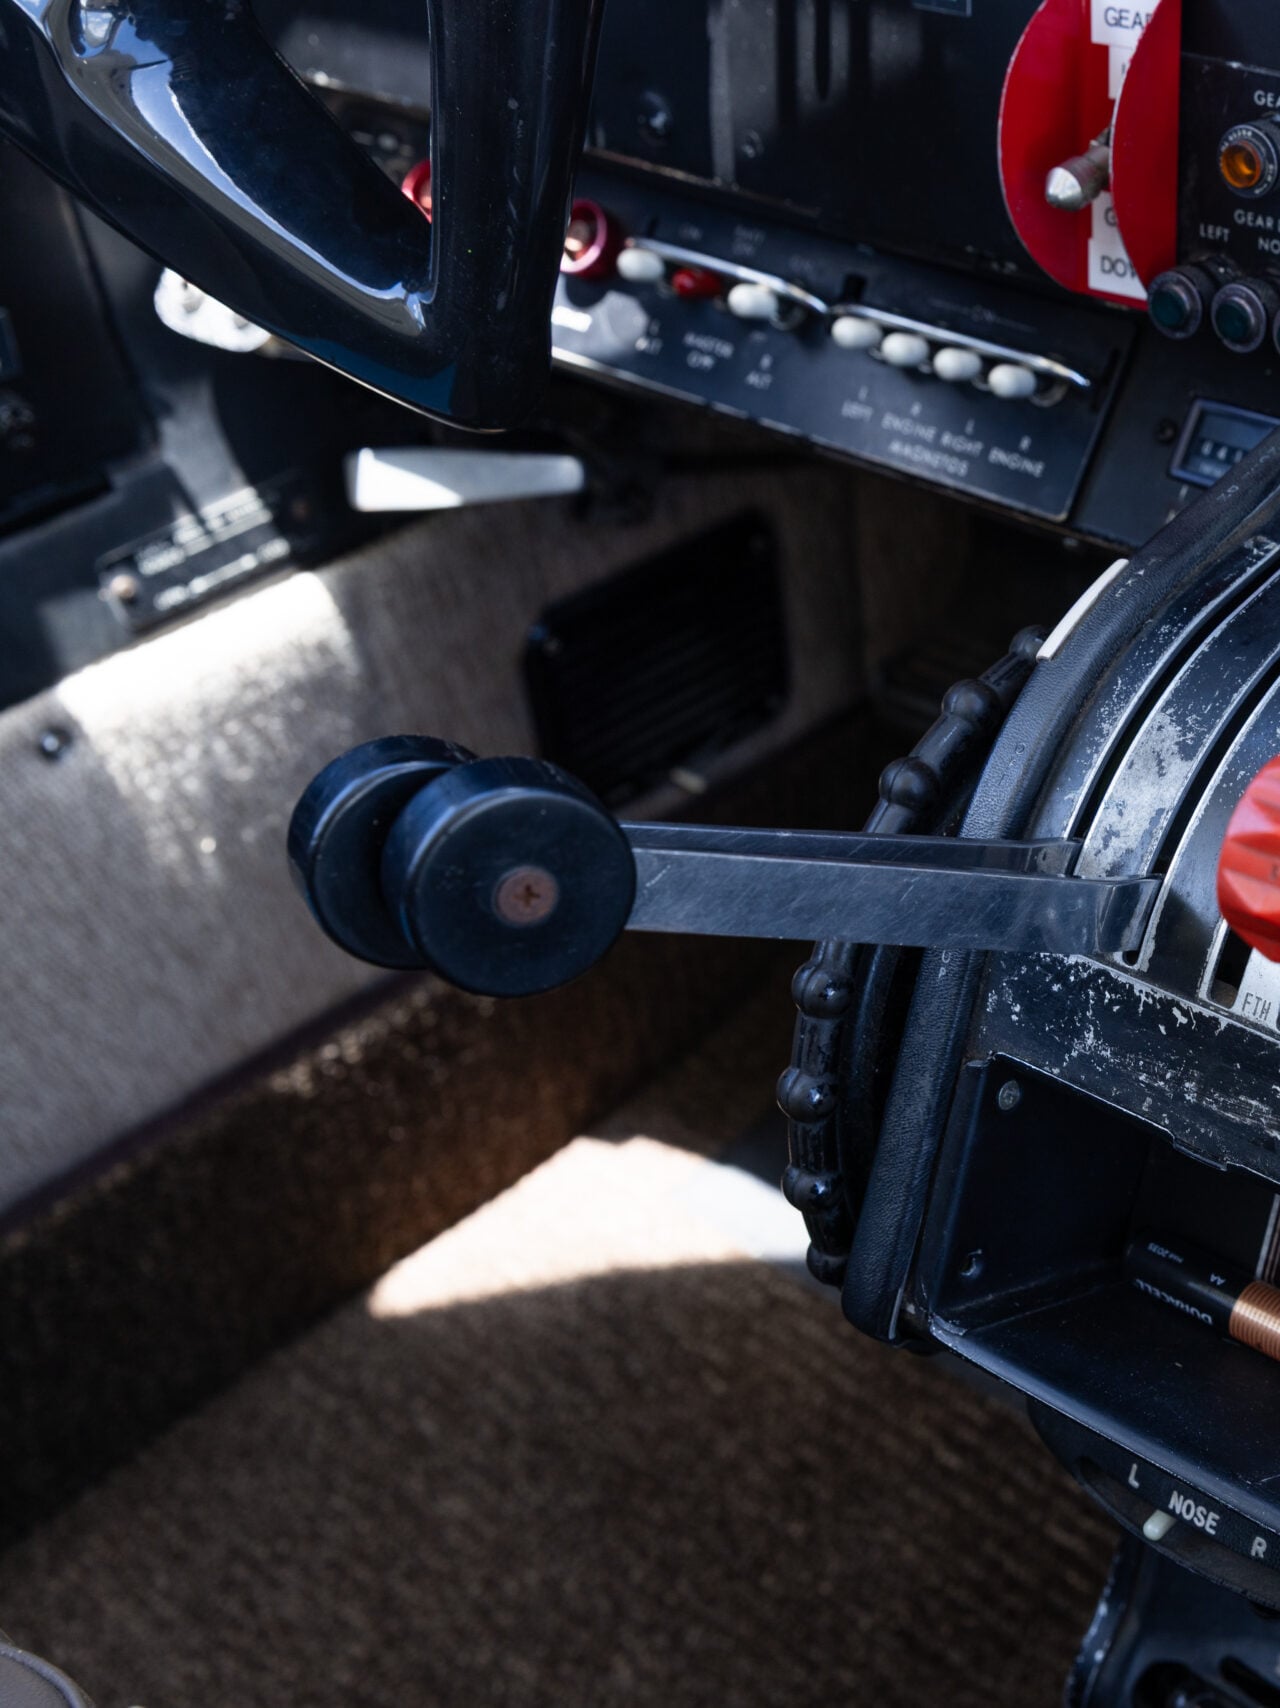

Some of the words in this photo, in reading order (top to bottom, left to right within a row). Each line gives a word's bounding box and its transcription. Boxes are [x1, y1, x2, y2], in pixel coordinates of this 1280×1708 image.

[1233, 208, 1275, 231] GEAR
[1199, 223, 1231, 243] LEFT
[1101, 255, 1137, 280] DO
[1242, 991, 1272, 1021] FTH
[1209, 1272, 1227, 1287] AA
[1135, 1278, 1214, 1326] DURACELL
[1128, 1463, 1140, 1489] L
[1168, 1490, 1221, 1536] NOSE
[1250, 1536, 1268, 1559] R
